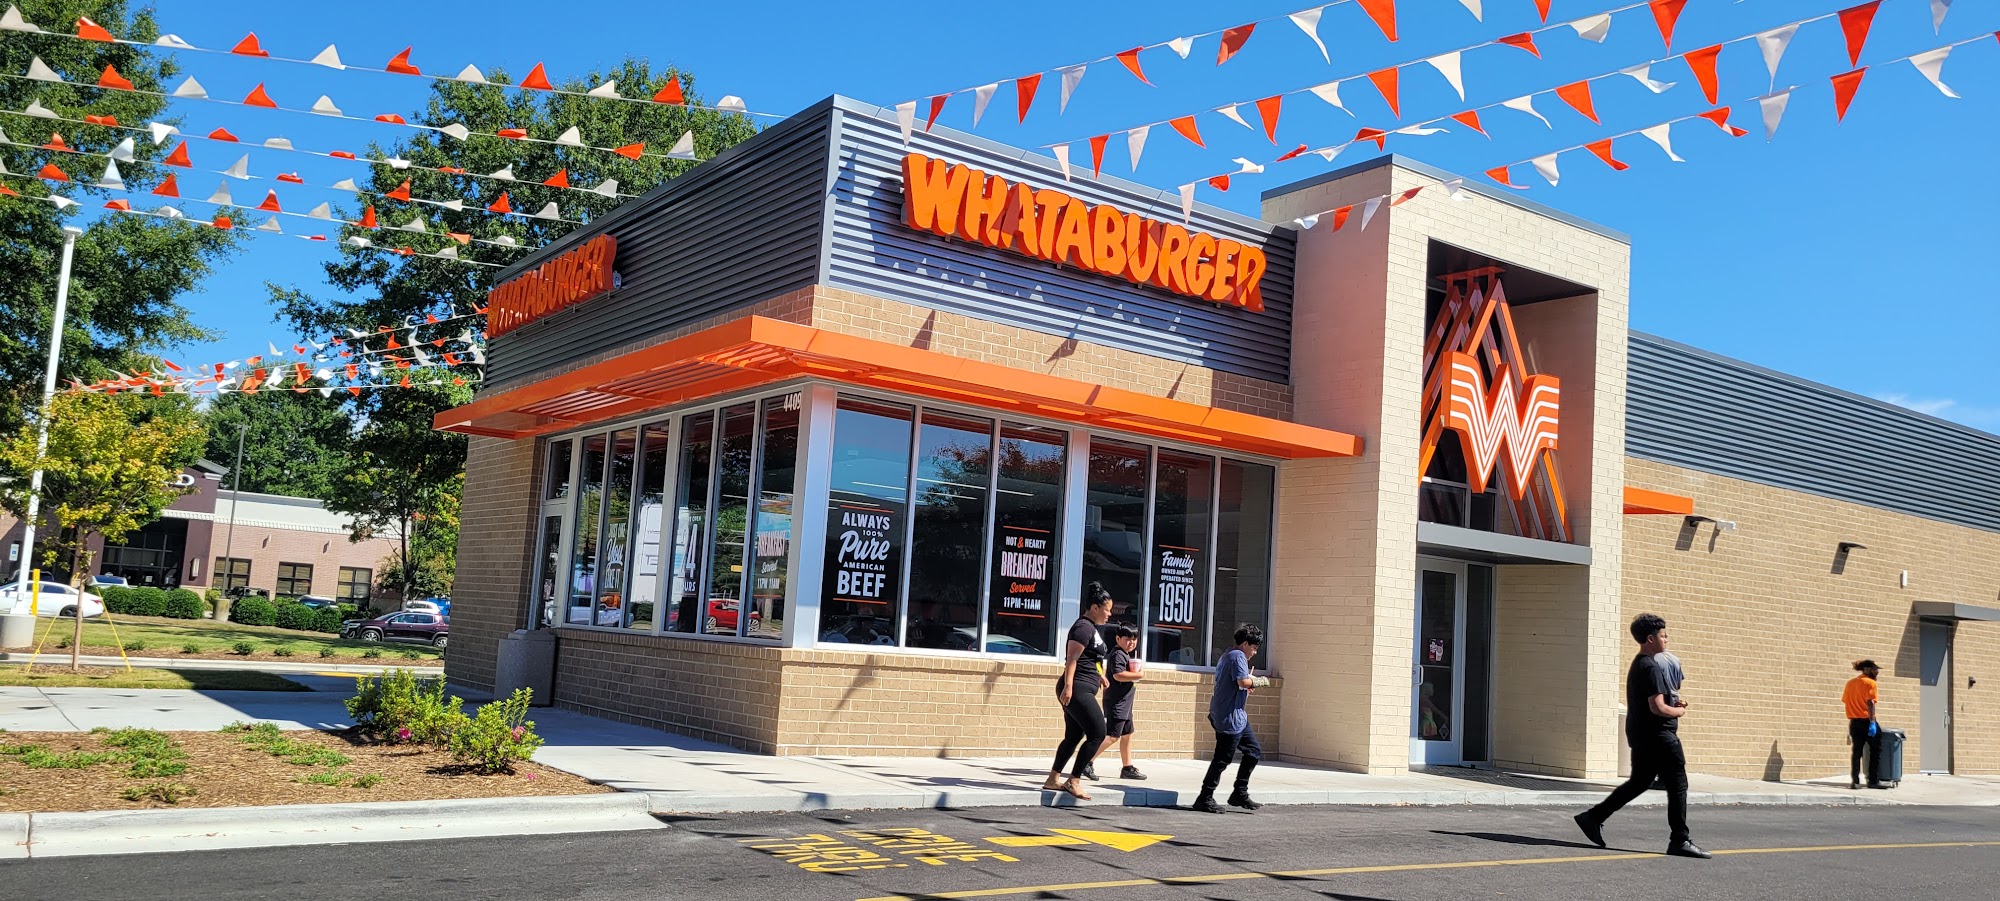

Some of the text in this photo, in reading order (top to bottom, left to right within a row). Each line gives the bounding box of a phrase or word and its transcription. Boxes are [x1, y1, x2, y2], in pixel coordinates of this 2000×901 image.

[902, 152, 1266, 312] WHATABURGER
[487, 233, 616, 339] WHATABURGER
[783, 392, 802, 412] 4409
[842, 512, 890, 530] ALWAYS
[862, 530, 883, 538] 100%
[1005, 536, 1046, 549] HOT & HEARTY
[838, 530, 890, 564] Pure
[761, 560, 778, 574] Served
[843, 562, 885, 571] AMERICAN
[1001, 551, 1048, 580] BREAKFAST
[1161, 567, 1176, 575] OWNED
[1162, 551, 1195, 576] Family
[837, 570, 886, 597] BEEF
[1009, 581, 1037, 594] Served
[1160, 574, 1194, 584] OPERATED SINCE
[1003, 597, 1041, 610] 11PM-11AM
[1159, 582, 1194, 624] 1950
[737, 833, 909, 873] THRU
[836, 828, 1021, 866] DRIVE
